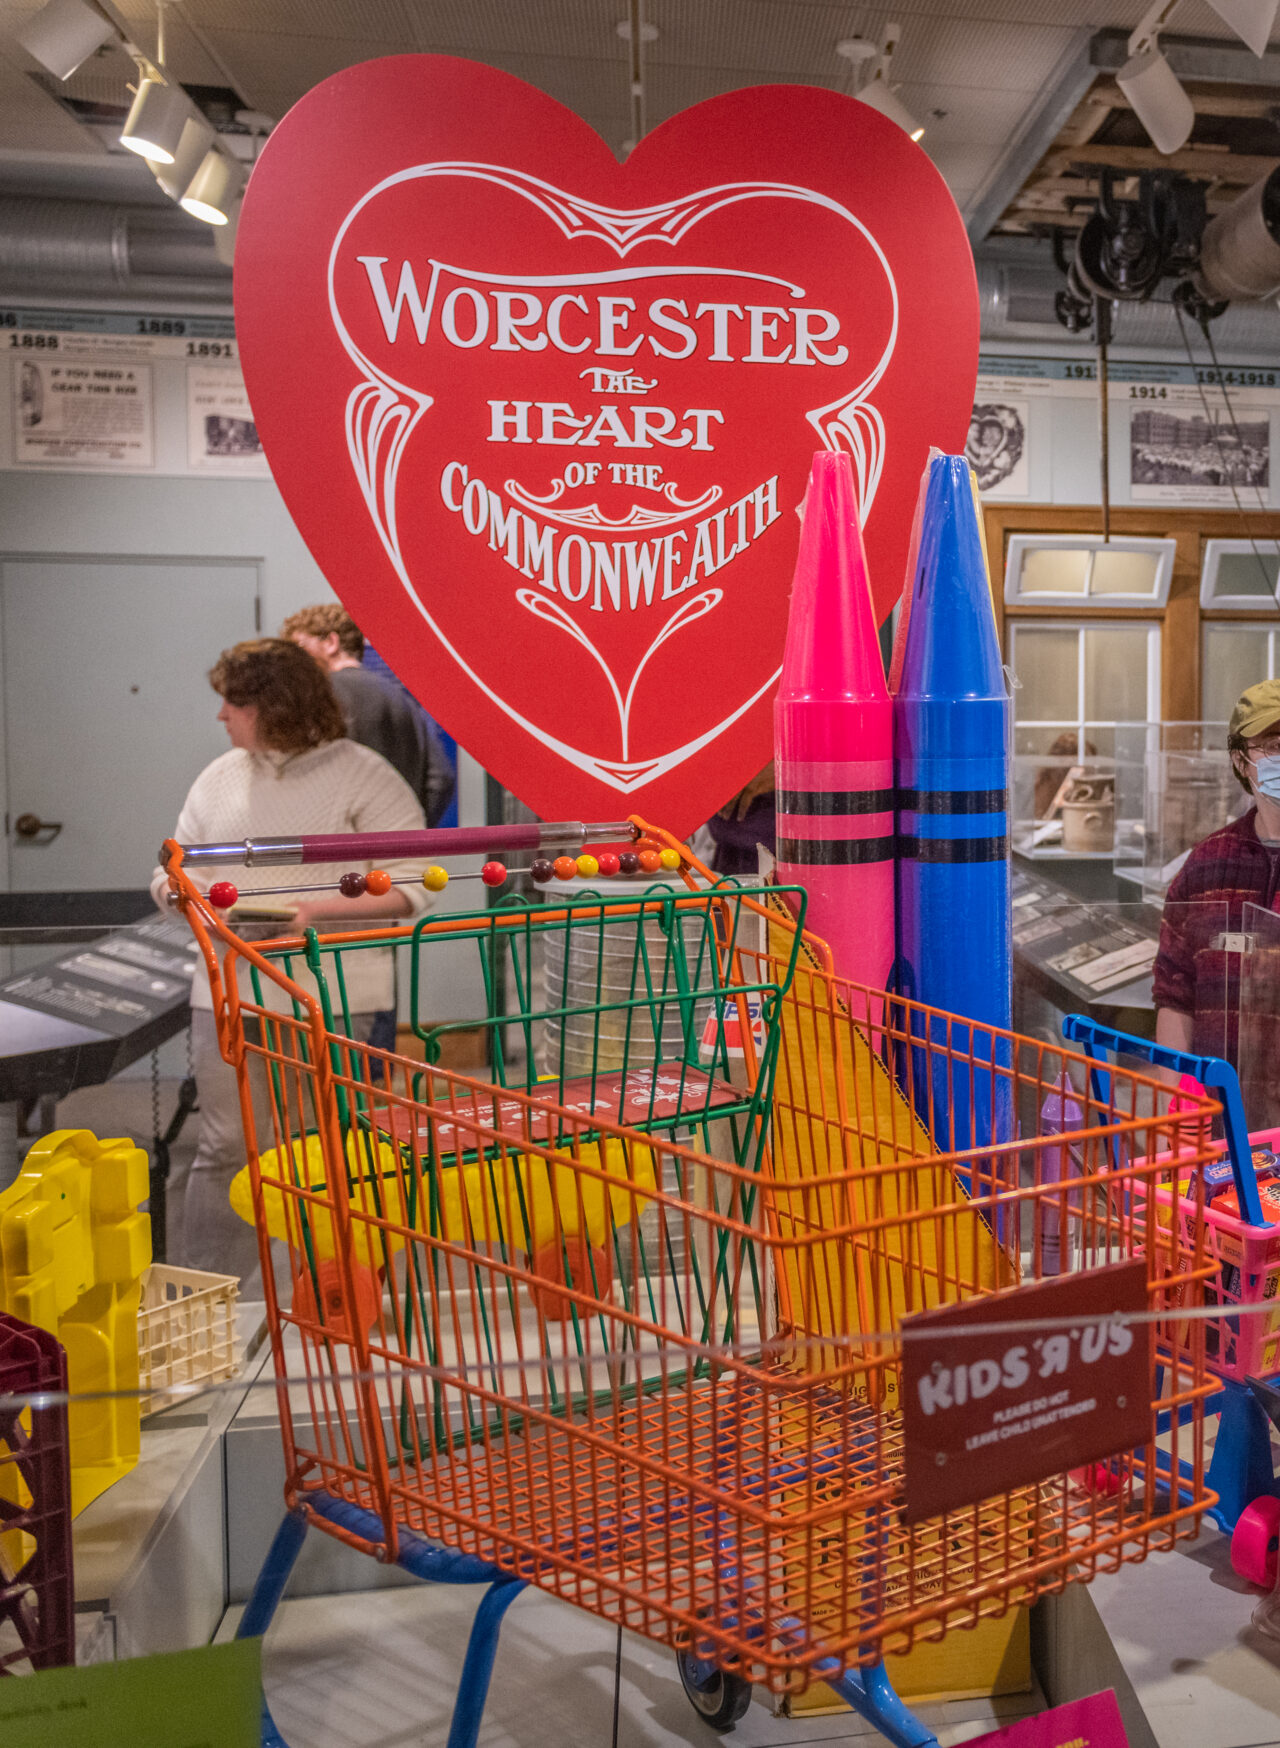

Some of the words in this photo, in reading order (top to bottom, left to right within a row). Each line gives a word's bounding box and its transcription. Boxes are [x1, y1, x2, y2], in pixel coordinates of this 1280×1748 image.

[138, 318, 186, 335] 1889
[357, 256, 849, 366] WORCESTER
[186, 341, 234, 358] 1891
[579, 367, 658, 395] THE
[1129, 386, 1168, 399] 1914
[1197, 370, 1276, 386] 1914-1918
[486, 400, 725, 451] HEART
[563, 462, 602, 488] OF
[608, 462, 666, 493] THE
[440, 461, 782, 612] COMMONWEALTH
[918, 1346, 1030, 1416] KIDS
[1080, 1318, 1134, 1364] US
[993, 1403, 1032, 1424] PLEASE
[1033, 1397, 1047, 1411] DO
[1048, 1390, 1070, 1407] NOT
[965, 1431, 999, 1451] LEAVE
[1000, 1419, 1031, 1440] CHILD
[1030, 1398, 1097, 1431] UNATTENDED
